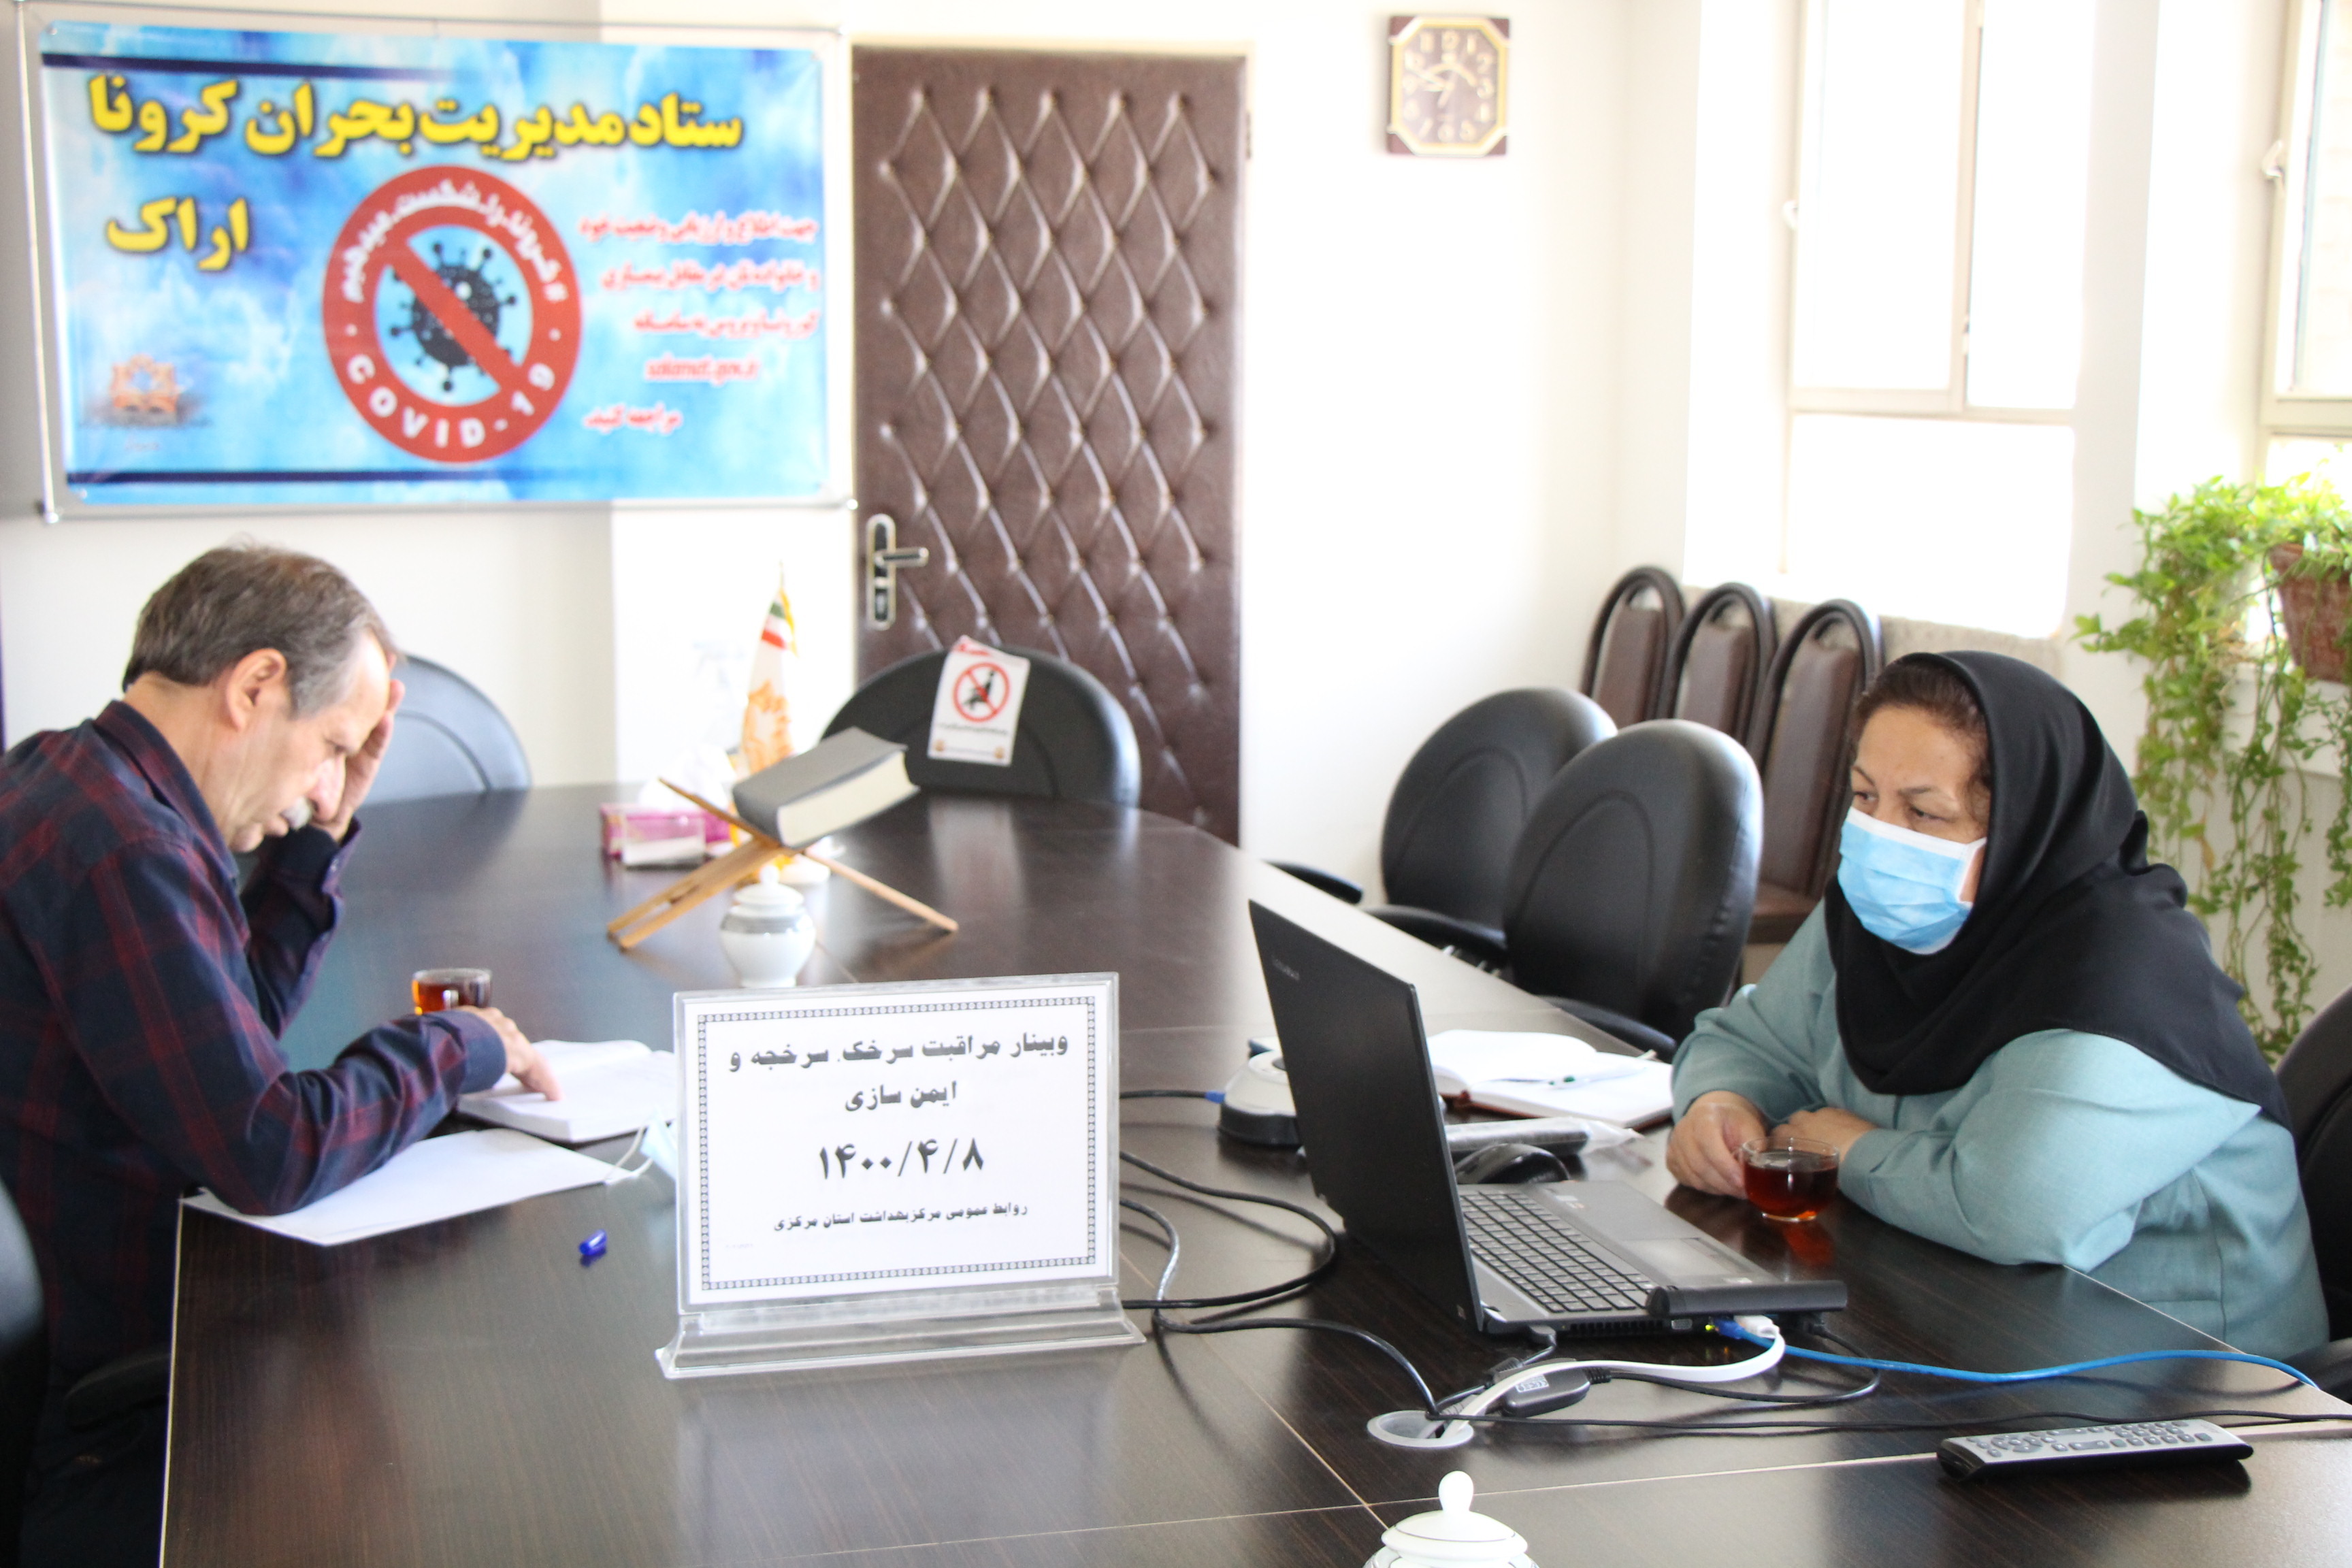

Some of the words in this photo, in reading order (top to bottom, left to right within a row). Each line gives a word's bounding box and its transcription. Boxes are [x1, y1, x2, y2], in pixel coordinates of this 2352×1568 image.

[88, 74, 238, 152] کرونا
[245, 82, 415, 157] بحران
[106, 197, 248, 270] اراک
[346, 354, 557, 449] COVID-19
[750, 1043, 830, 1071] سرخجه
[921, 1034, 1001, 1061] مراقبت
[1009, 1032, 1069, 1059] وبینار
[728, 1051, 742, 1073] و
[844, 1083, 902, 1113] سازی
[909, 1080, 958, 1109] ایمن
[818, 1137, 985, 1181] ۱۴۰۰/۴/۸
[773, 1215, 819, 1232] مرکزی
[822, 1212, 855, 1229] استان
[945, 1207, 988, 1222] عمومی
[992, 1202, 1028, 1217] روابط
